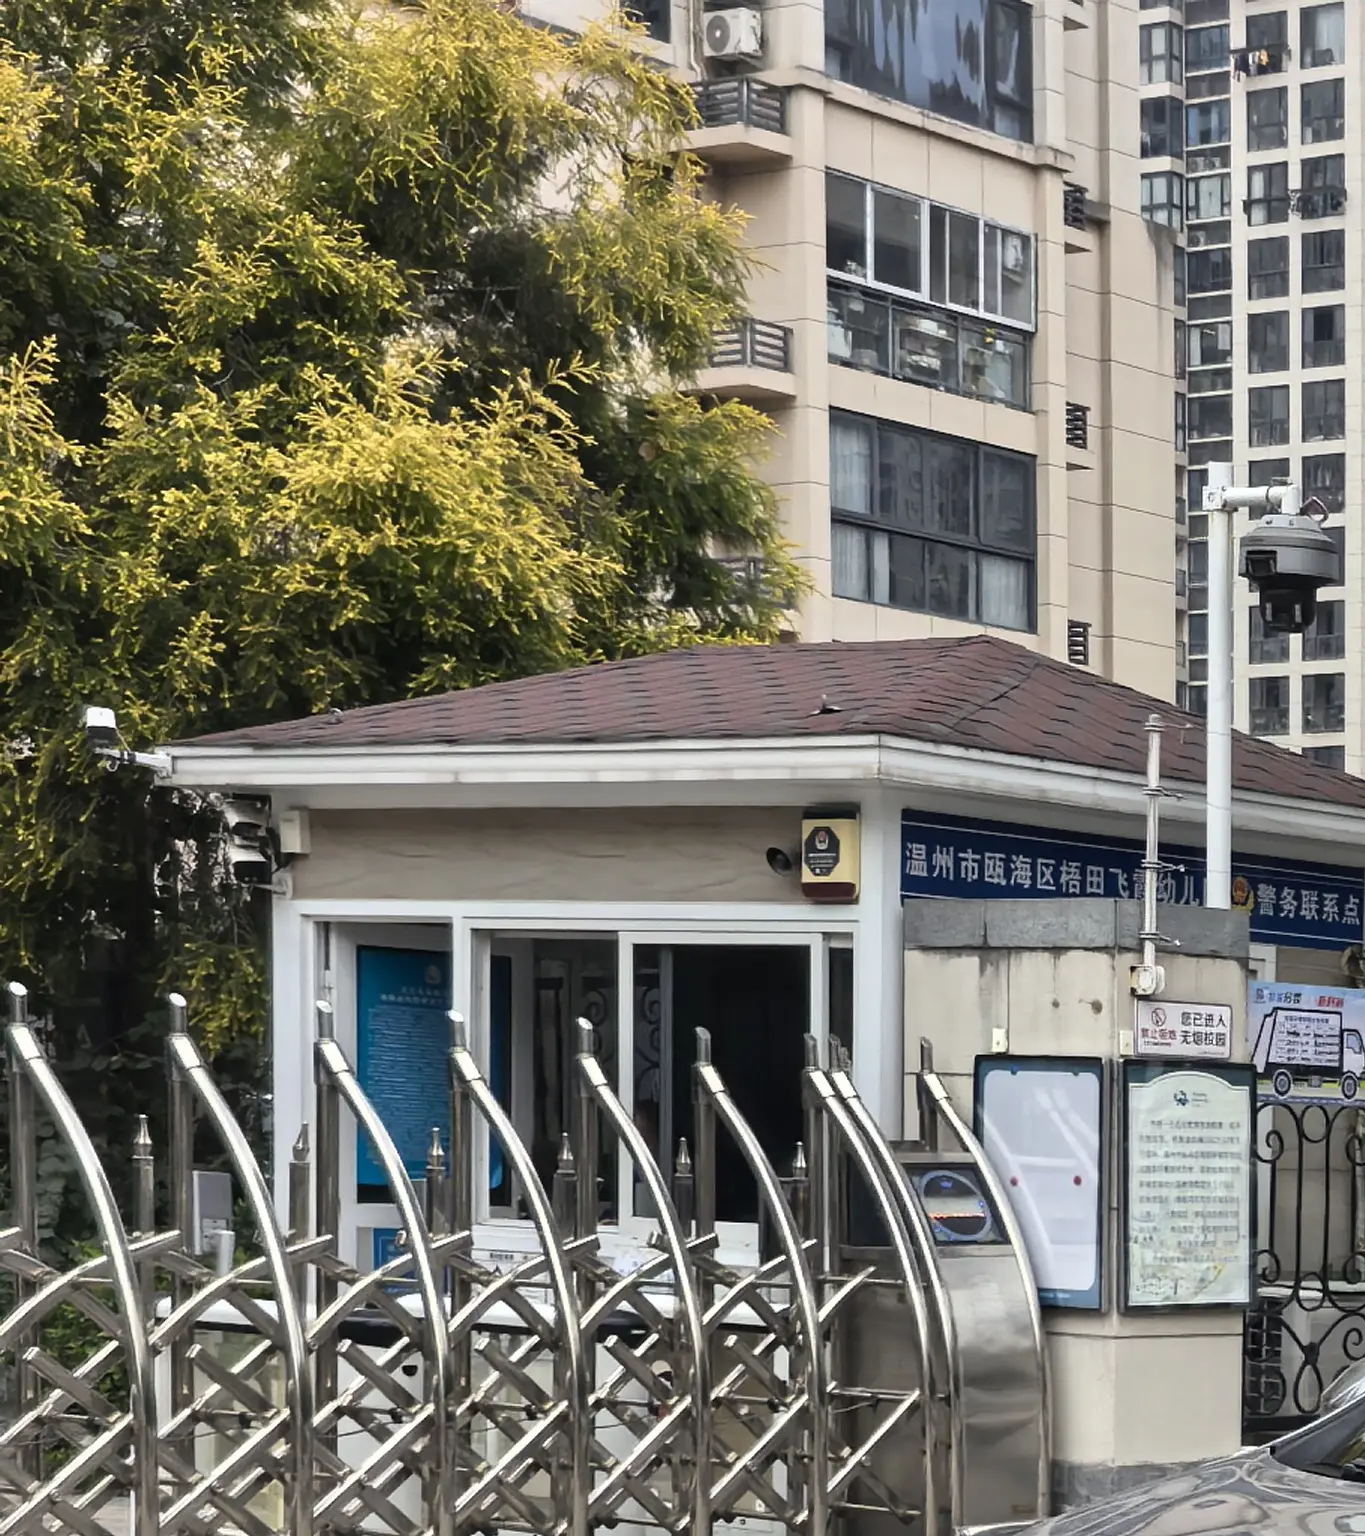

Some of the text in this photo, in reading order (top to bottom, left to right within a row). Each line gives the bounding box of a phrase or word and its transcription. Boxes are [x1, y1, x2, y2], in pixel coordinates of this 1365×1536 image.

[905, 842, 1361, 926] 温州市瓯海区梧田飞霞幼儿 警务联系点
[1181, 1011, 1227, 1028] 您已进入
